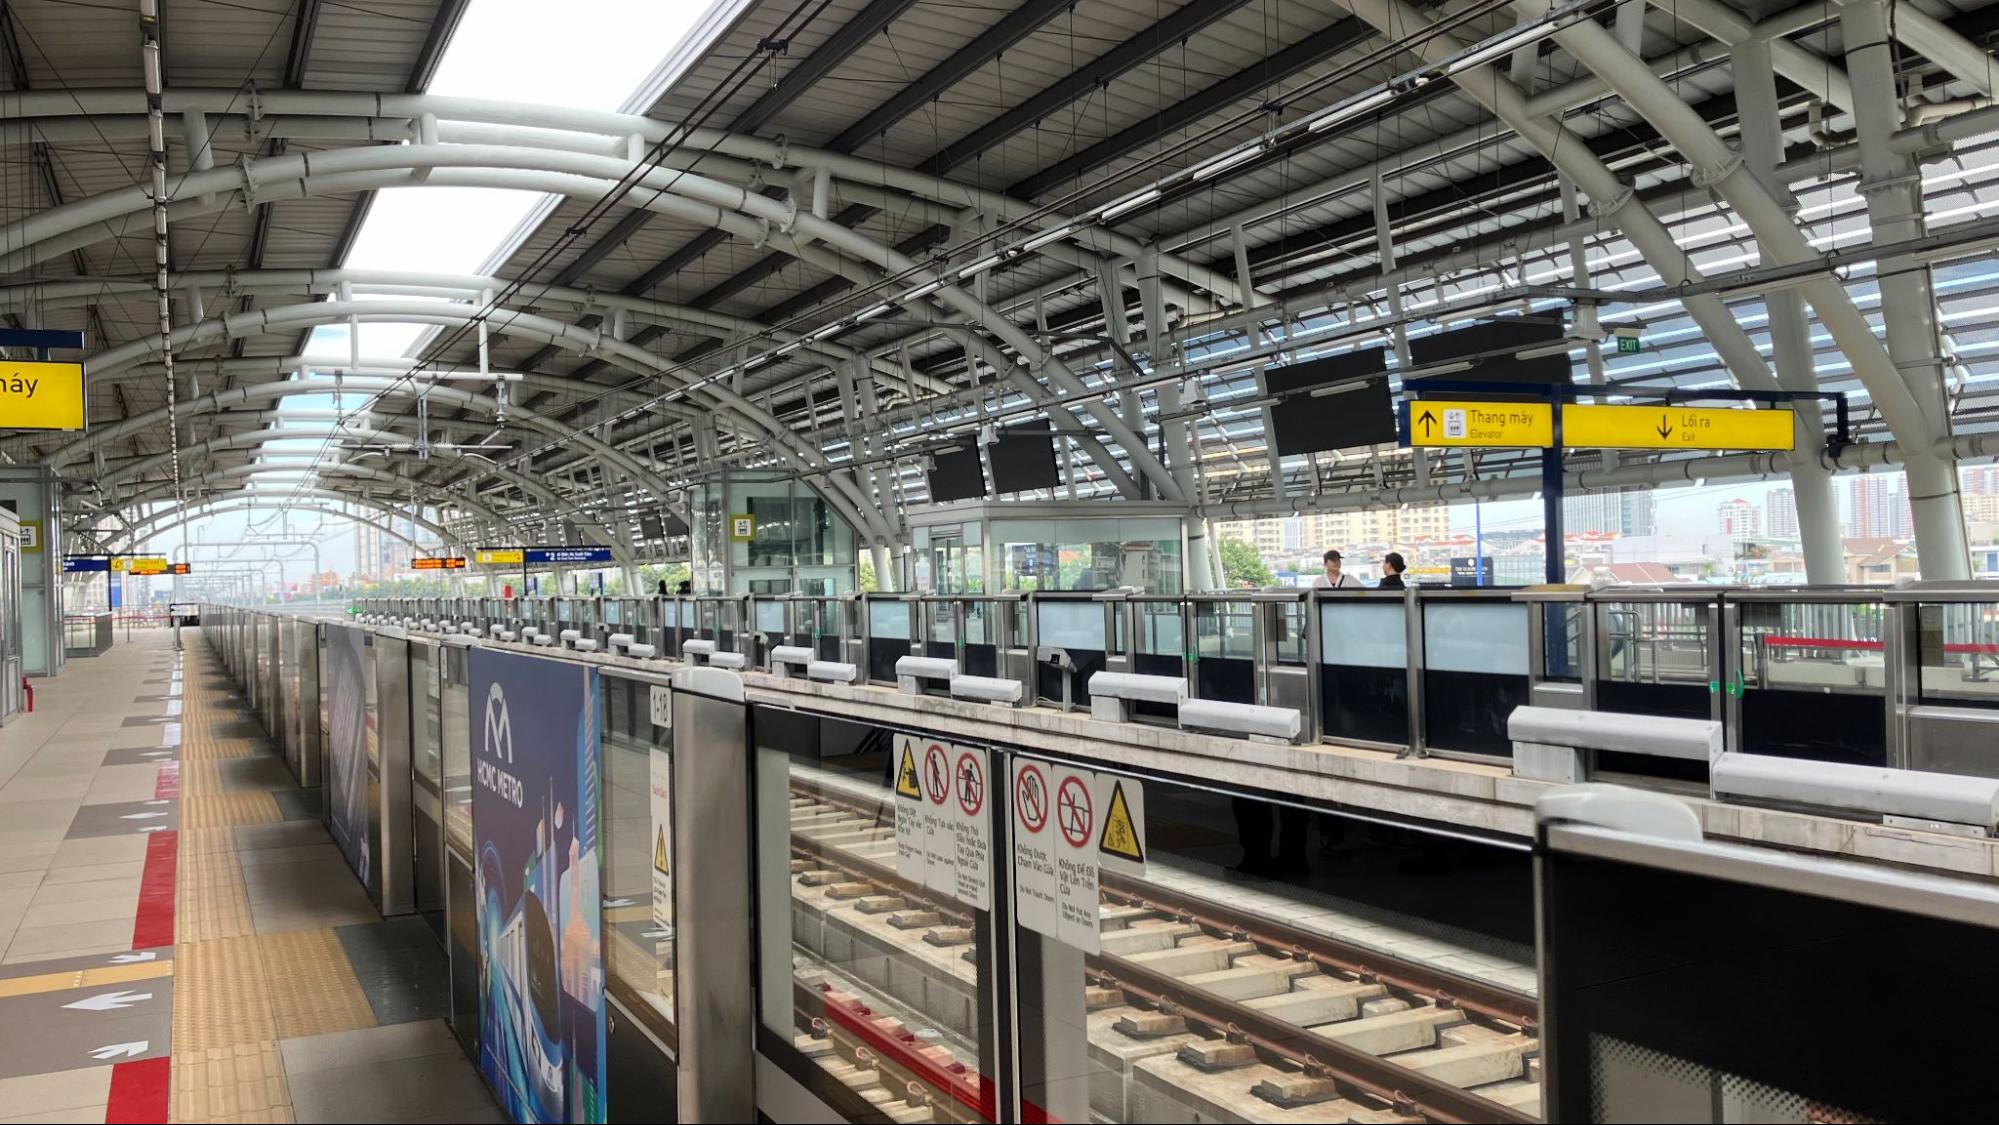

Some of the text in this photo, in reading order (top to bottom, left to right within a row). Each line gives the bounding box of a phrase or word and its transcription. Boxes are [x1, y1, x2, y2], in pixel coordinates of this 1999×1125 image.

[1621, 339, 1636, 351] EXIT
[1470, 409, 1533, 427] Thang máy
[1682, 413, 1710, 428] Lối ra
[1470, 429, 1504, 439] Elevator
[653, 690, 668, 722] 1-18
[477, 759, 523, 808] HCMC METRO
[1017, 843, 1033, 859] Không
[1059, 858, 1076, 877] Không
